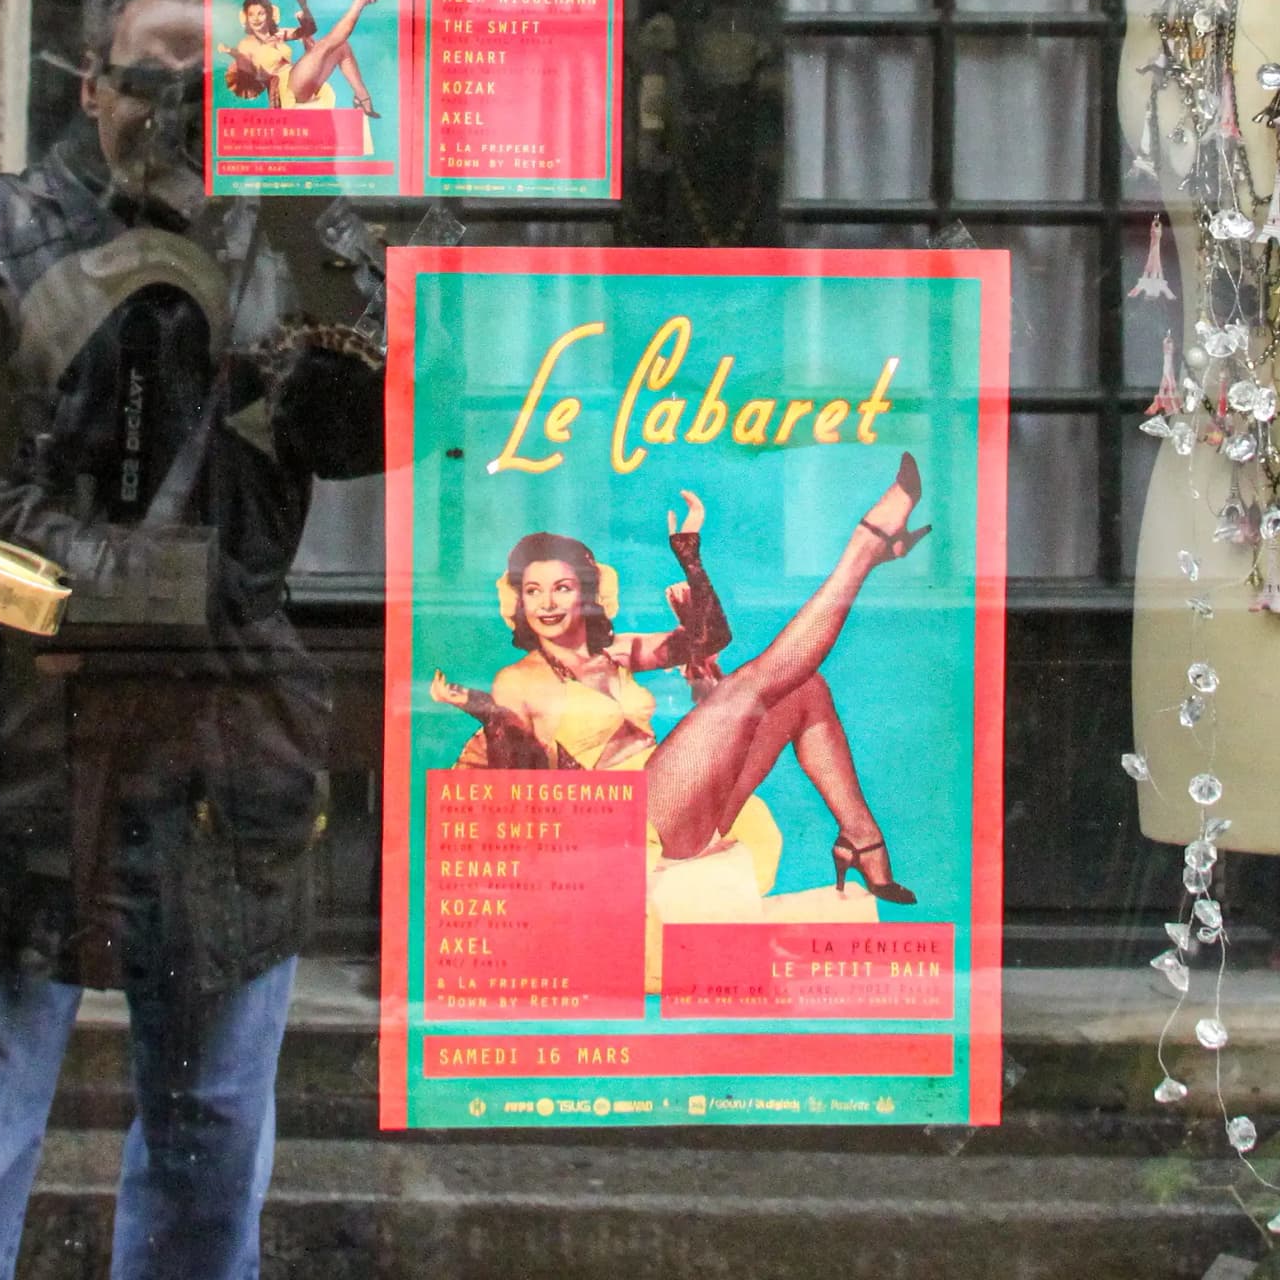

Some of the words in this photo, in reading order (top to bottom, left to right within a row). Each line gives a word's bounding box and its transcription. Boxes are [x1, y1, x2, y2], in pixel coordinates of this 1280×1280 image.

[442, 19, 473, 34] THE
[487, 20, 541, 35] SWIFT
[442, 51, 507, 65] RENART
[442, 81, 496, 95] KOZAK
[441, 111, 485, 125] AXEL
[485, 320, 607, 476] Le
[609, 314, 901, 476] Cabaret
[441, 783, 493, 801] ALEX
[511, 783, 633, 801] NIGGEMANN
[441, 822, 480, 839] THE
[496, 822, 562, 839] SWIFT
[440, 860, 521, 878] RENART
[440, 899, 507, 916] KOZAK
[439, 937, 493, 954] AXEL
[811, 938, 834, 953] LA
[851, 935, 939, 953] PÉNICHE
[771, 961, 795, 977] LE
[811, 961, 873, 977] PETIT
[890, 961, 941, 977] BAIN
[439, 1048, 518, 1065] SAMEDI
[536, 1048, 561, 1065] 16
[577, 1047, 631, 1064] MARS
